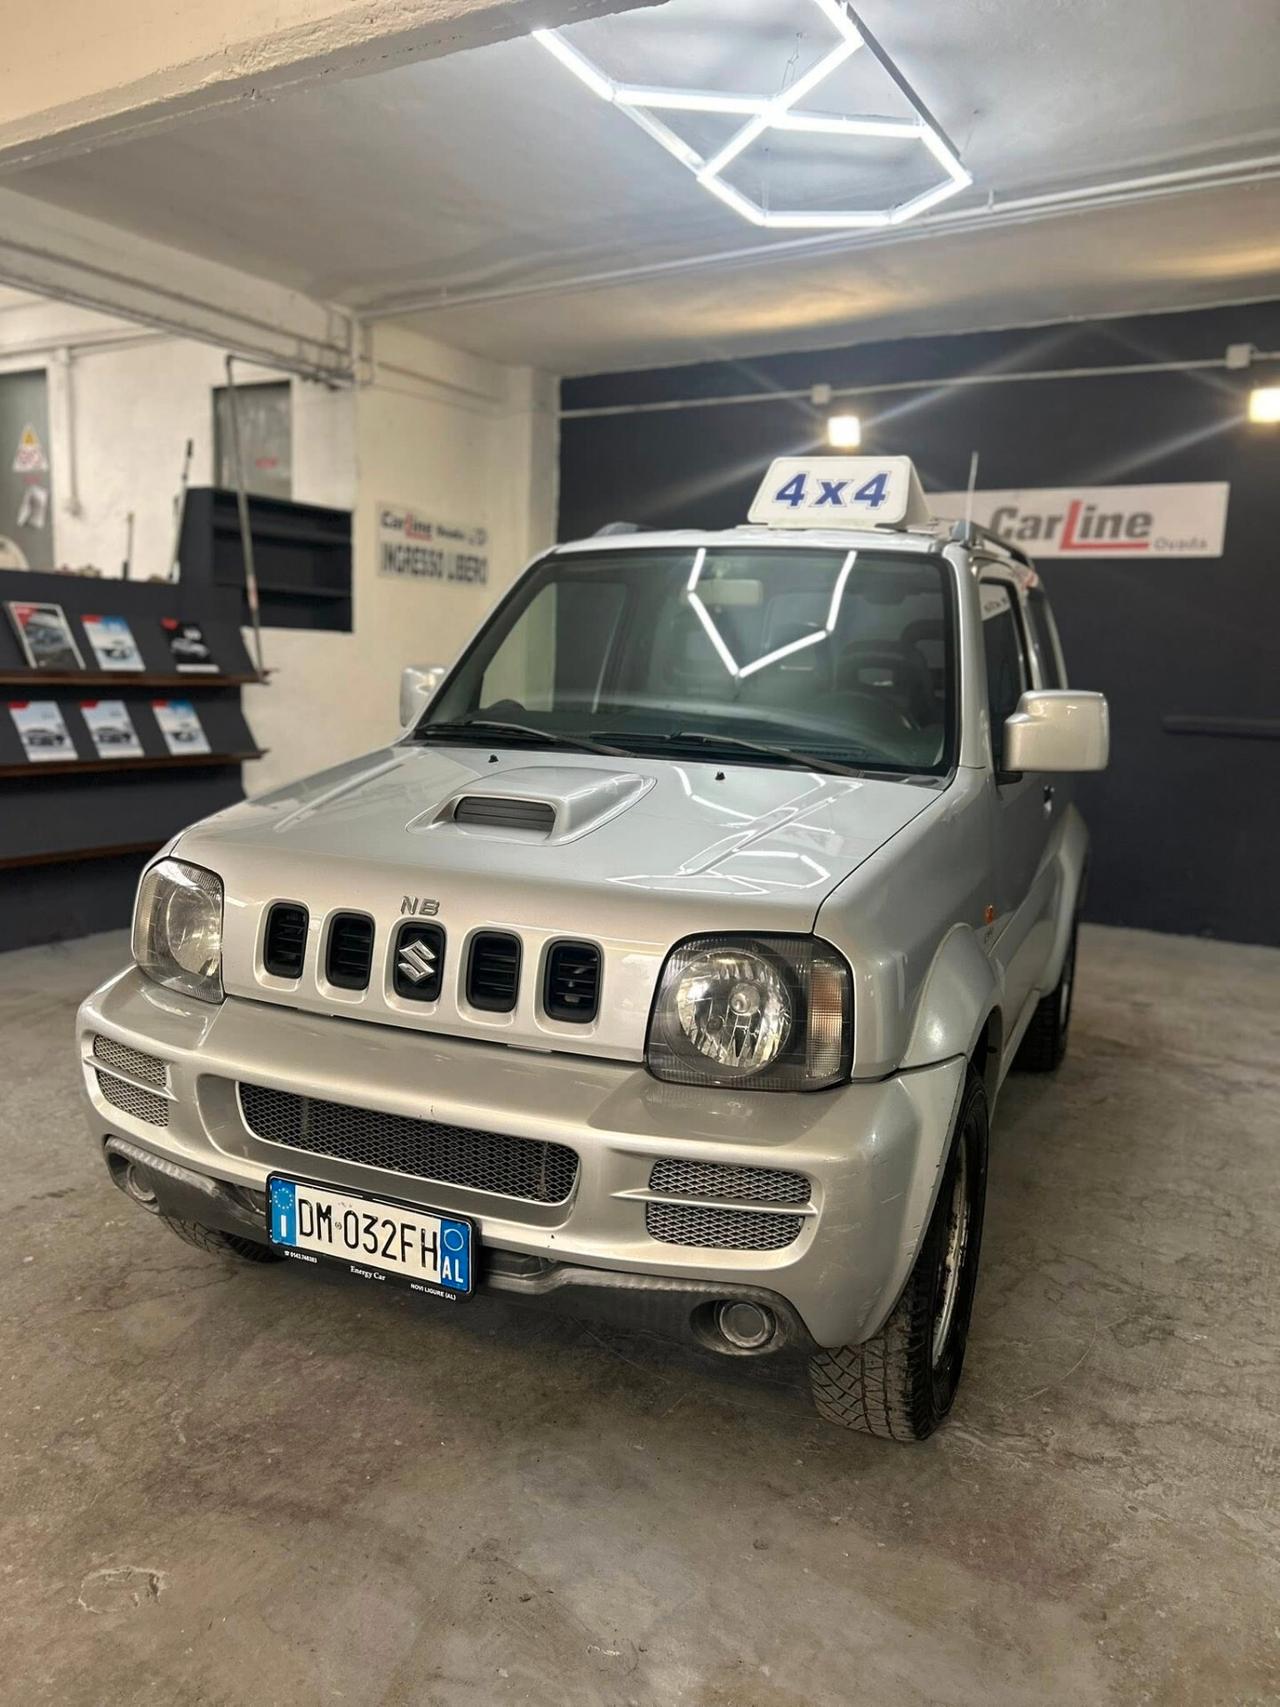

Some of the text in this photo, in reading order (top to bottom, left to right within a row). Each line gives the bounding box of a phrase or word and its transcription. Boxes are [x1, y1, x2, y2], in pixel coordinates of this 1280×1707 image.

[381, 510, 432, 541] CarLine
[989, 499, 1153, 552] CarLine
[383, 542, 487, 585] INGRESSO LIBERO
[350, 1265, 386, 1281] Energy Car
[442, 1256, 464, 1283] AL
[411, 1283, 423, 1292] NOVI
[424, 1287, 444, 1298] LIGURE
